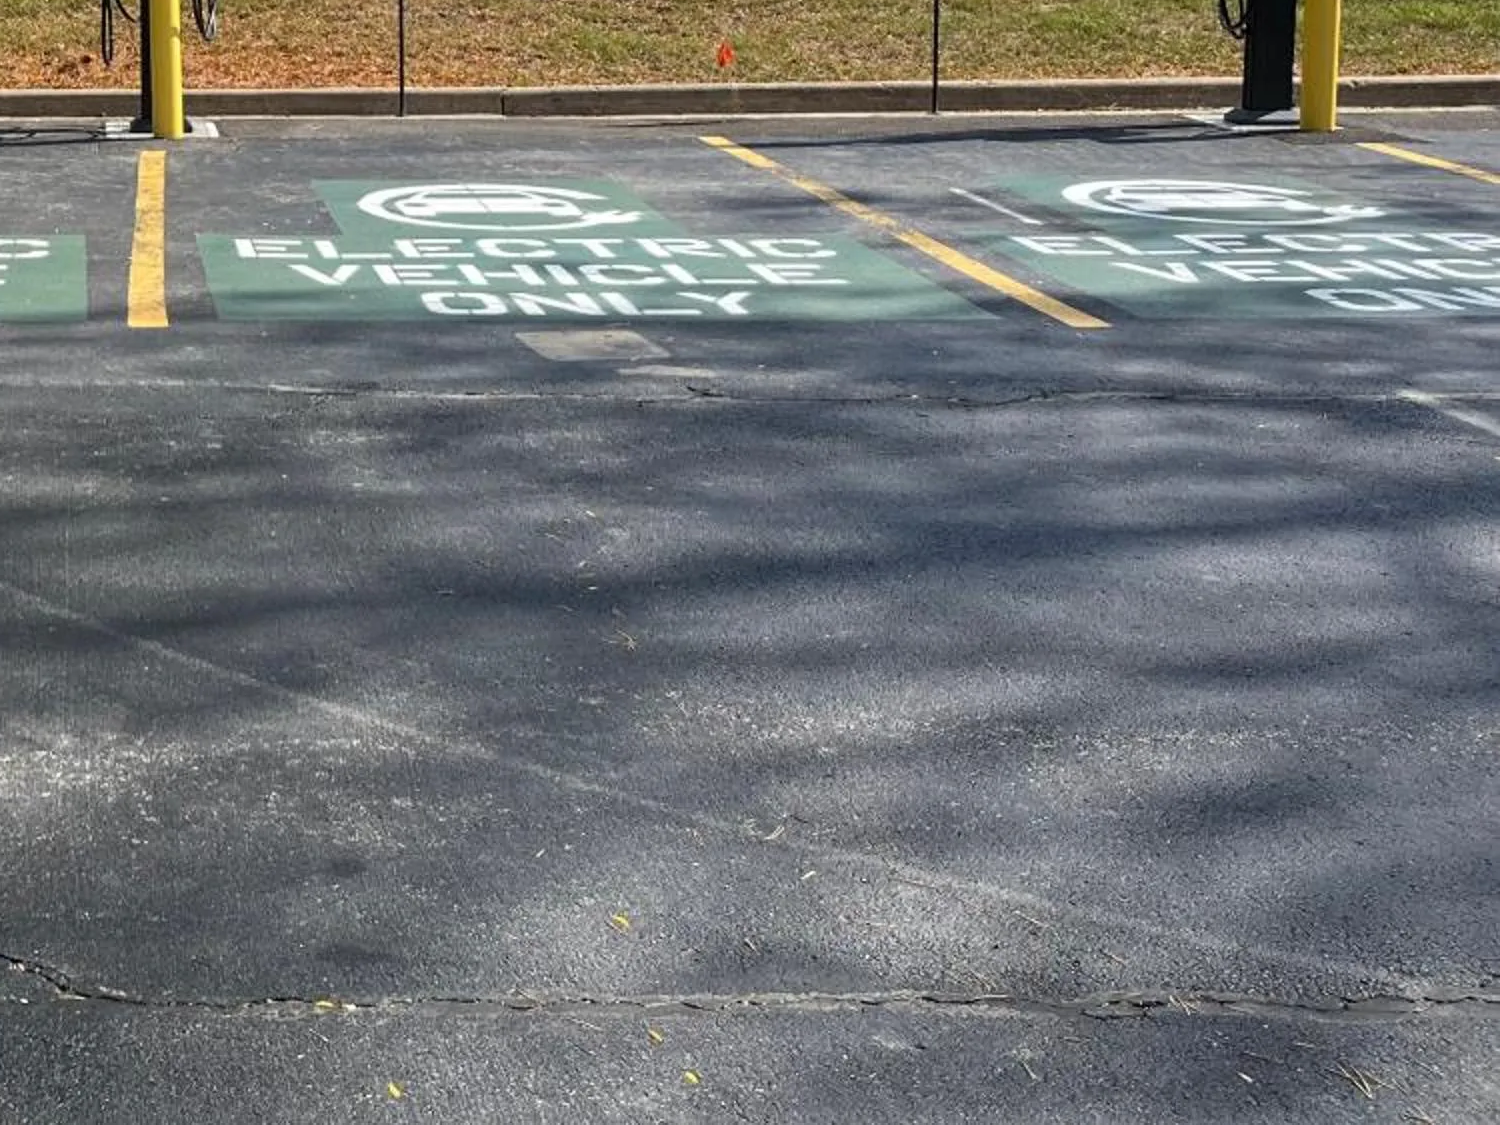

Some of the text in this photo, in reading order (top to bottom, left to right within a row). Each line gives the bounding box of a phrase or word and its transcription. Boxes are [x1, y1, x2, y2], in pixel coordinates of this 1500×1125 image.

[232, 238, 839, 260] ELECTRIC
[290, 262, 849, 286] VEHICLE
[1108, 258, 1500, 282] VEHIC
[420, 290, 753, 317] ONLY
